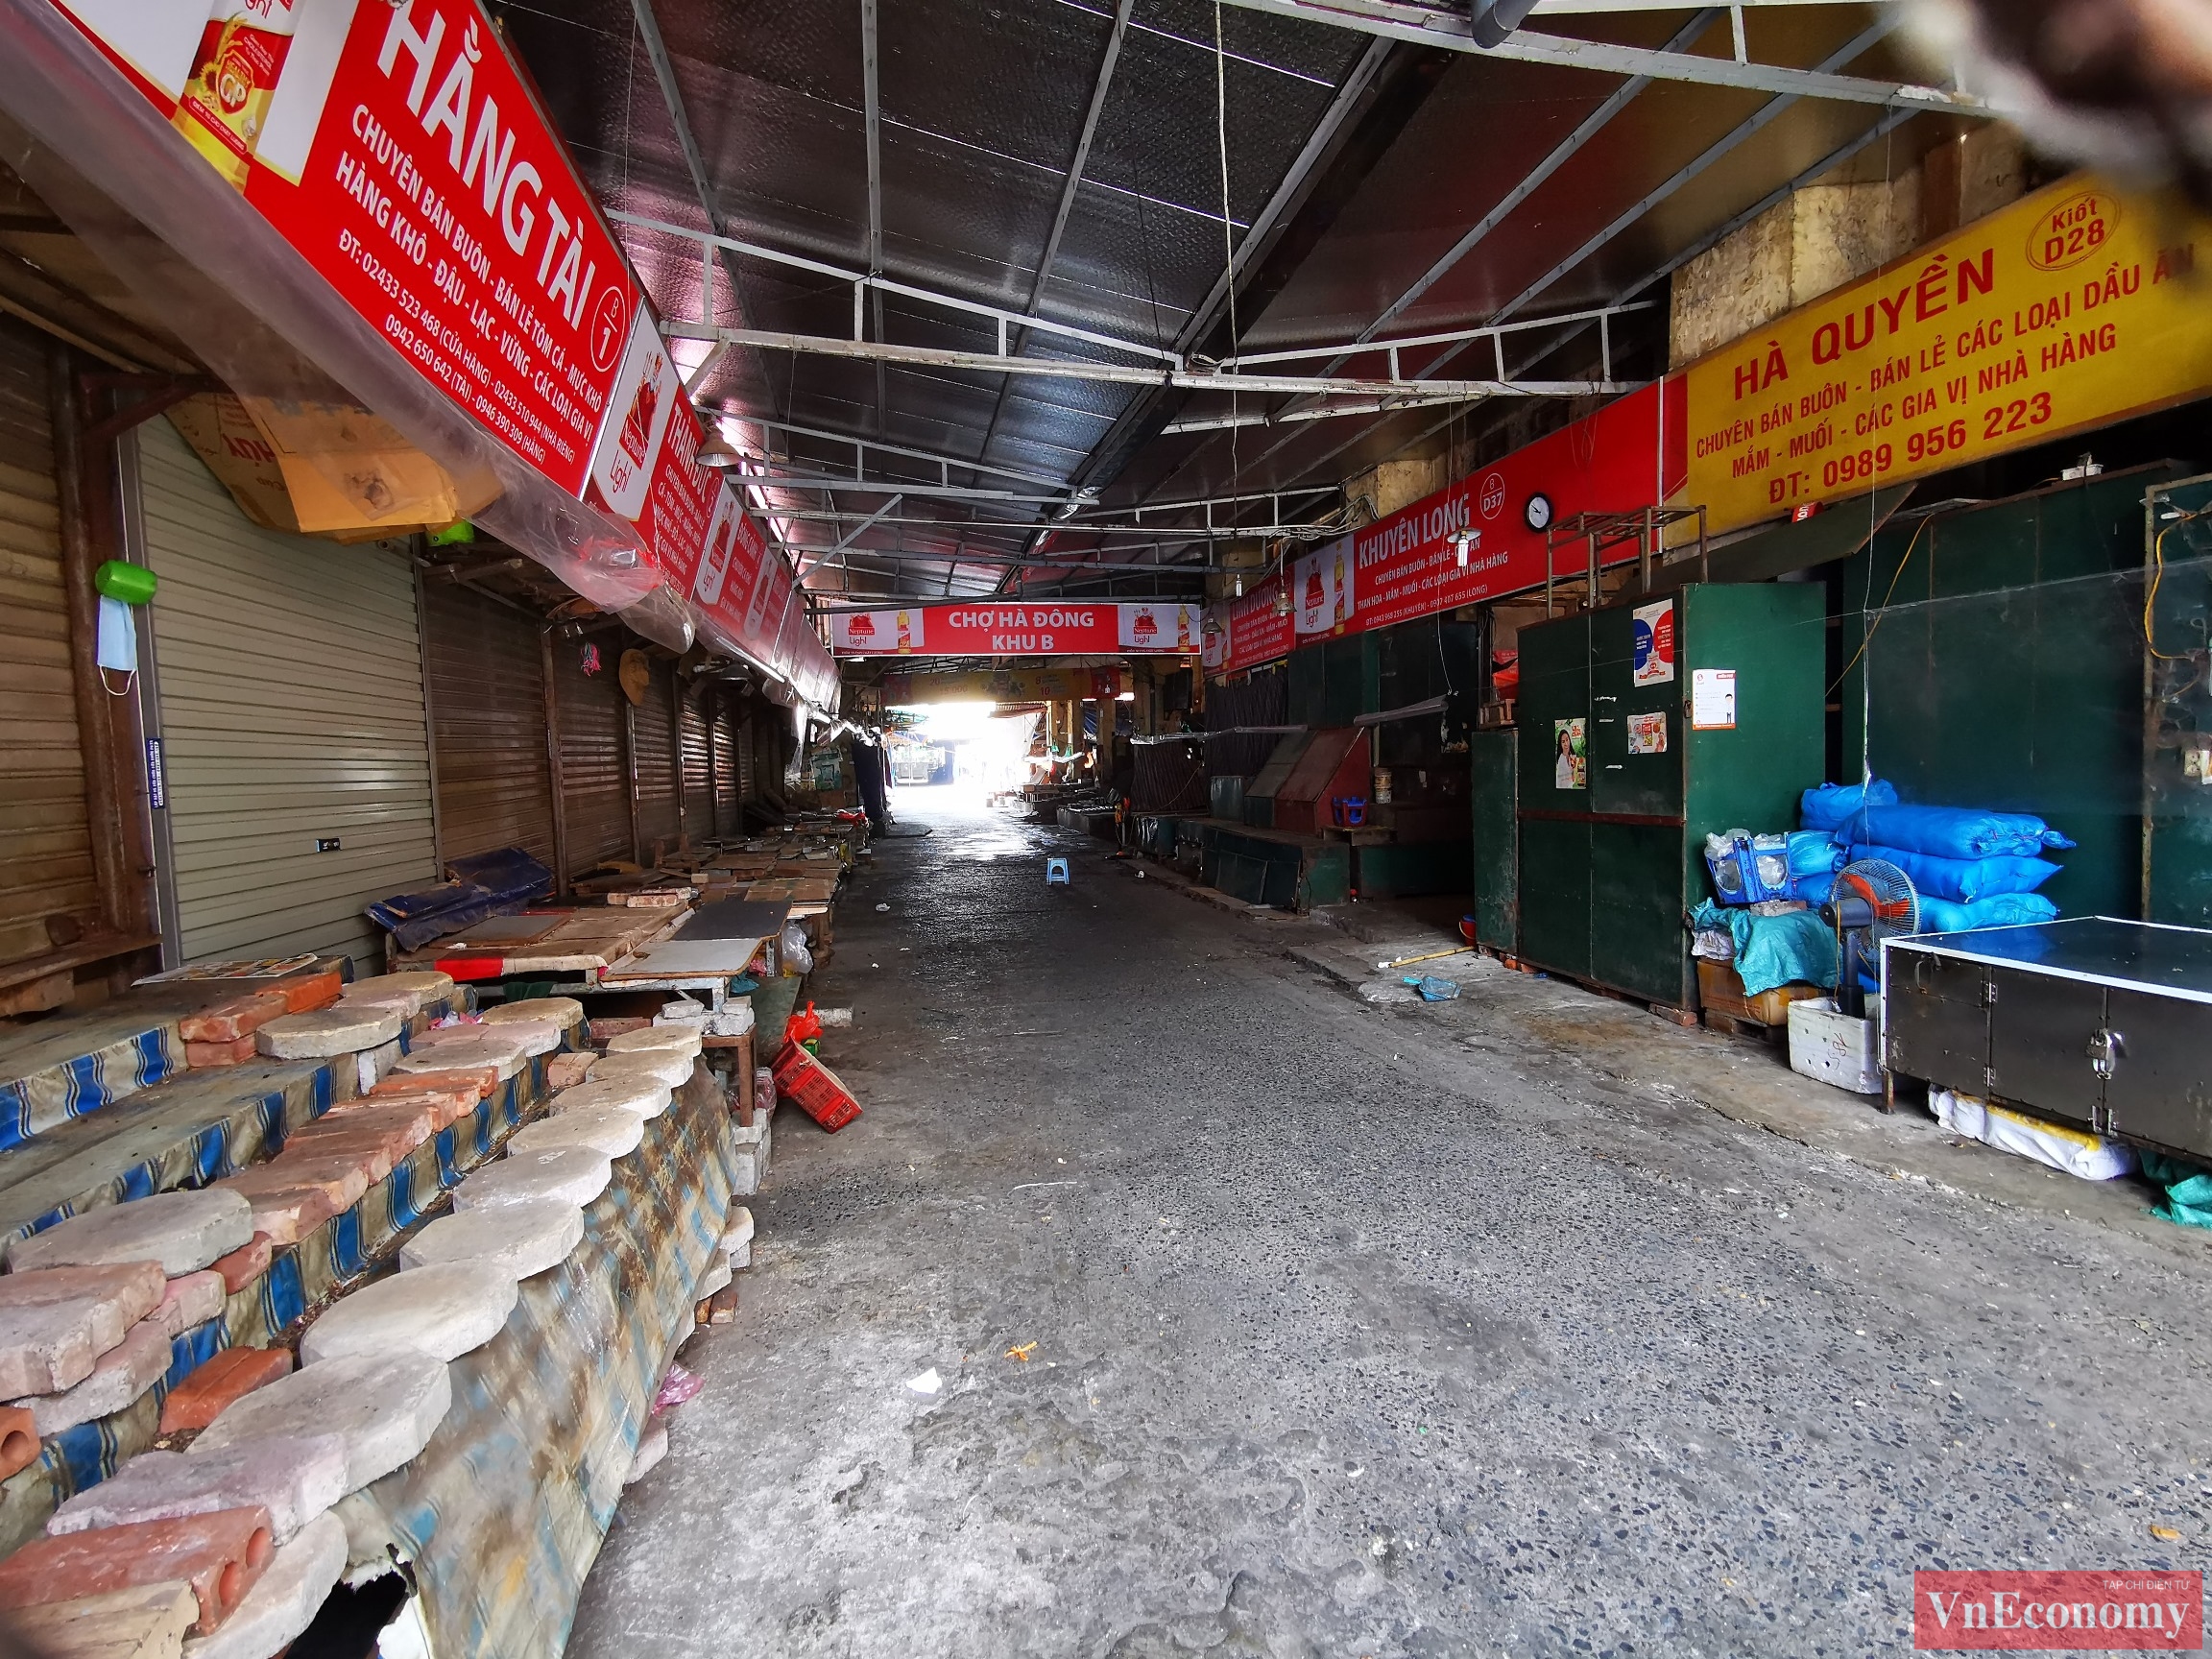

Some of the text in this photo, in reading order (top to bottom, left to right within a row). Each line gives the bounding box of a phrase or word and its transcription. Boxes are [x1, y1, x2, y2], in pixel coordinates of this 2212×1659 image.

[377, 0, 596, 331] HẰNG TÀI
[2051, 196, 2098, 233] Kiốt
[352, 104, 603, 413] CHUYÊN BÁN BUÔN BÁN LẺ TÔM CÁ MỰC KHÔ
[2044, 218, 2105, 265] D28
[336, 150, 594, 447] HÀNG KHÔ ĐẬU LẠC VỪNG CÁC LOẠI GIA VỊ
[338, 228, 363, 264] ĐT:
[362, 252, 400, 299] 02433
[398, 288, 421, 319] 523
[420, 309, 441, 337] 468
[439, 325, 463, 361] (CỬA
[463, 348, 492, 389] HÀNG)
[494, 380, 517, 411] 02433
[598, 327, 612, 361] 1
[1734, 247, 1994, 401] HÀ QUYỀN
[385, 313, 415, 349] 0942
[413, 339, 434, 366] 650
[433, 355, 452, 383] 642
[450, 370, 472, 403] (TÀI)
[475, 395, 496, 422] 0946
[495, 411, 510, 433] 390
[509, 425, 523, 445] 309
[1696, 419, 1754, 459] CHUYÊN
[1760, 399, 1792, 434] BÁN
[1800, 381, 1847, 419] BUÔN
[1870, 355, 1911, 393] BÁN
[1920, 334, 1947, 373] LẺ
[1957, 318, 2003, 358] CÁC
[2014, 292, 2071, 337] LOẠI
[2083, 261, 2141, 311] DẦU
[1732, 323, 2117, 478] MẮM MUỐI CÁC GIA VỊ NHÀ HÀNG
[621, 419, 646, 464] Neptune
[1769, 391, 2053, 504] ĐT: 0989 956 223
[610, 449, 633, 493] Light
[1483, 492, 1503, 513] D37
[1358, 493, 1470, 569] KHUYÊN LONG
[850, 637, 867, 646] Light
[949, 609, 1094, 633] CHỢ HÀ ĐÔNG
[1134, 636, 1150, 644] Light
[1306, 609, 1319, 627] Light
[992, 635, 1054, 651] KHU B
